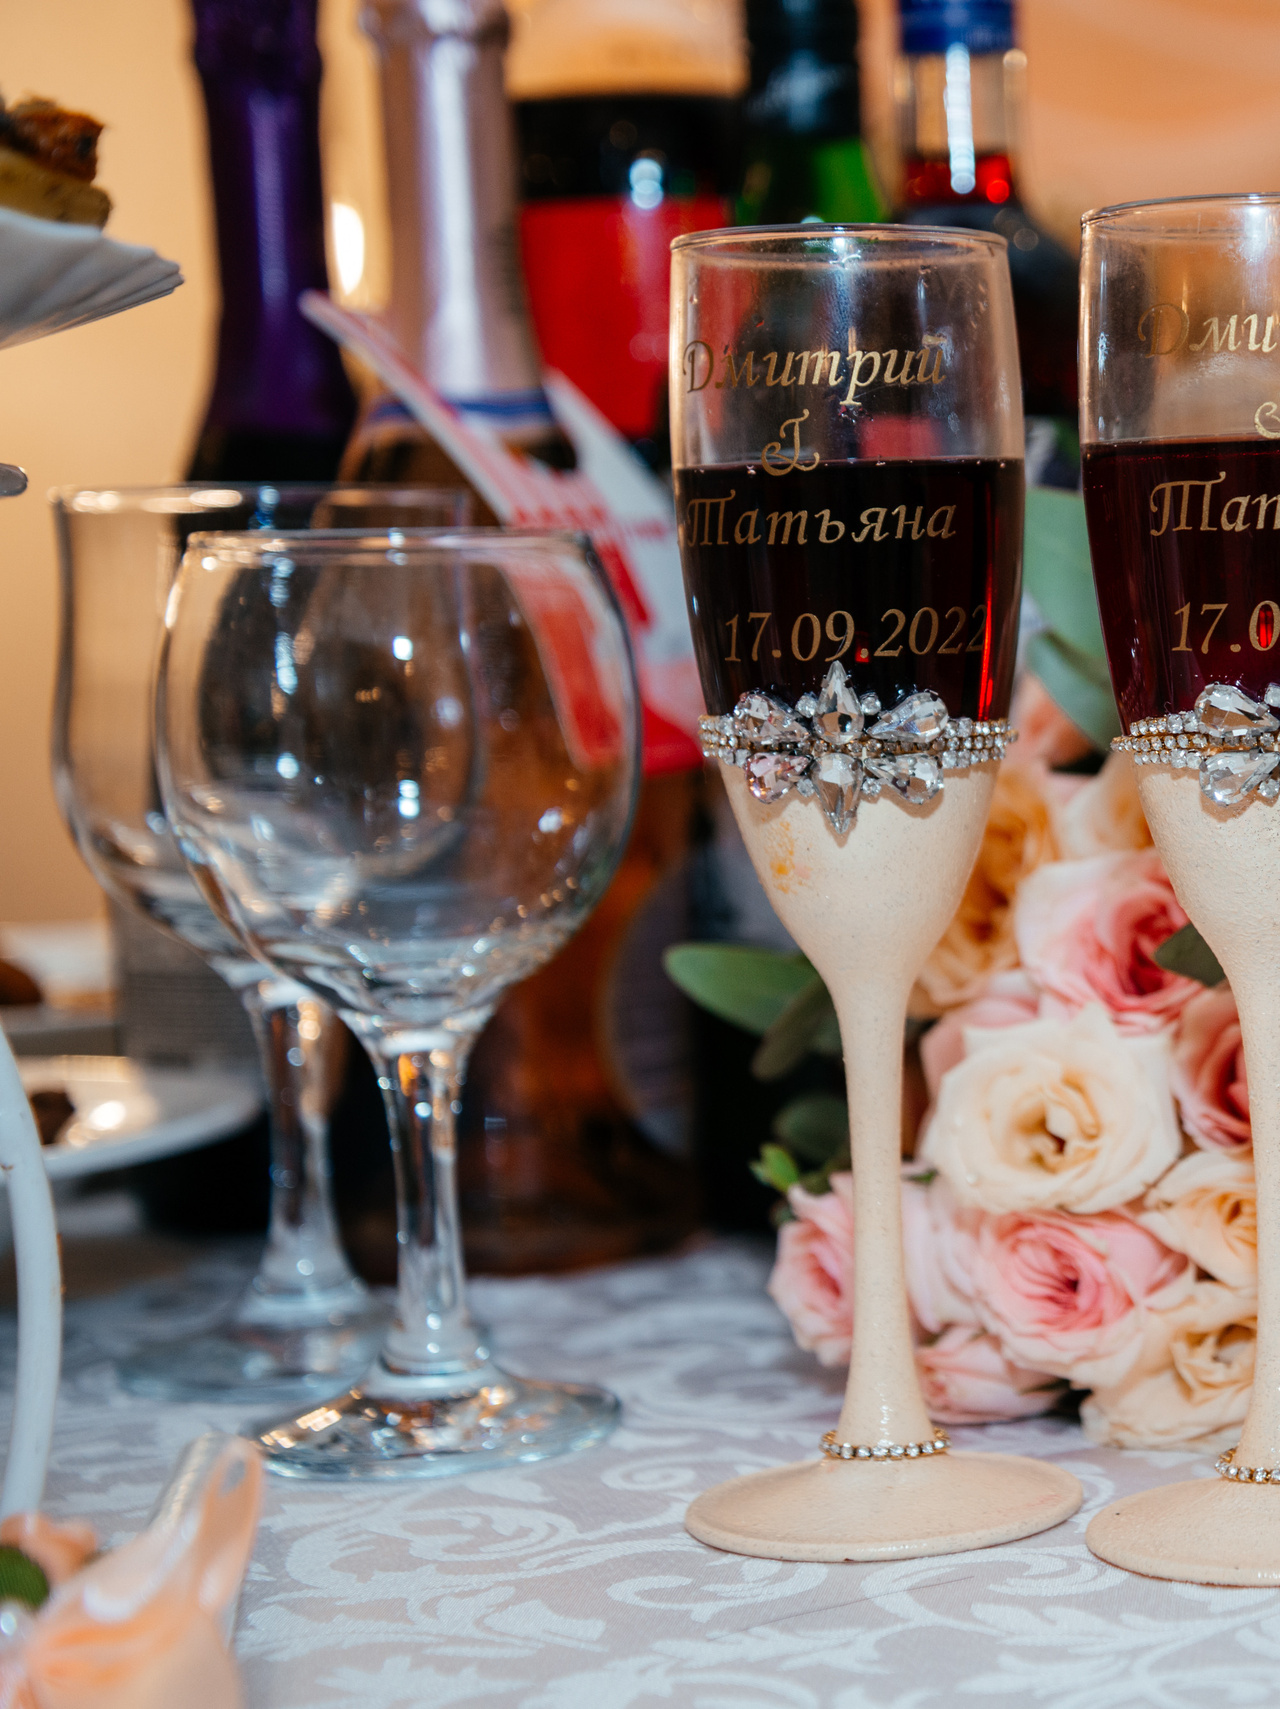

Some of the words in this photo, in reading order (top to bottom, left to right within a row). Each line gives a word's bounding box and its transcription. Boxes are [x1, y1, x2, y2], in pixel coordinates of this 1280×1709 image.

[683, 335, 947, 405] Дмитрий
[686, 489, 957, 547] Татьяна
[724, 603, 989, 662] 17.09.2022
